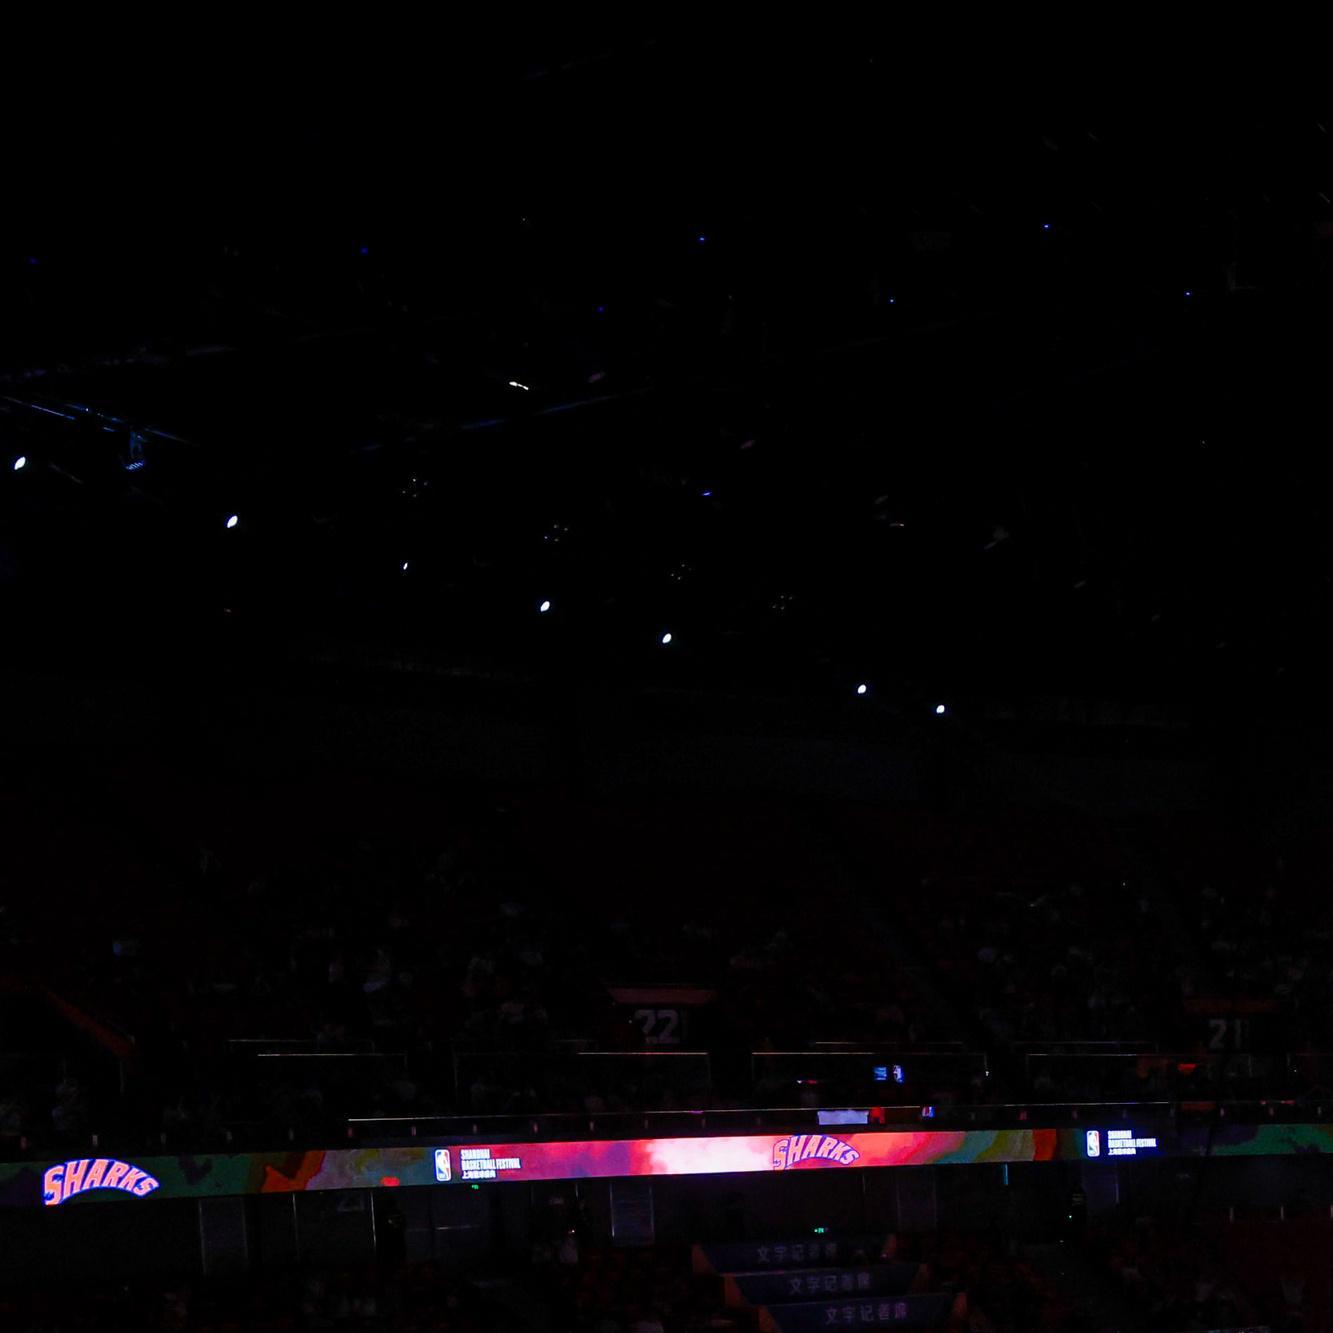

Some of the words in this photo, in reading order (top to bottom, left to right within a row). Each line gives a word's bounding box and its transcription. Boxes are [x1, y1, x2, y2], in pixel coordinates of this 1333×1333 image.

[634, 1008, 682, 1045] 22
[773, 1135, 860, 1171] SHARKS
[43, 1158, 160, 1206] SHARKS
